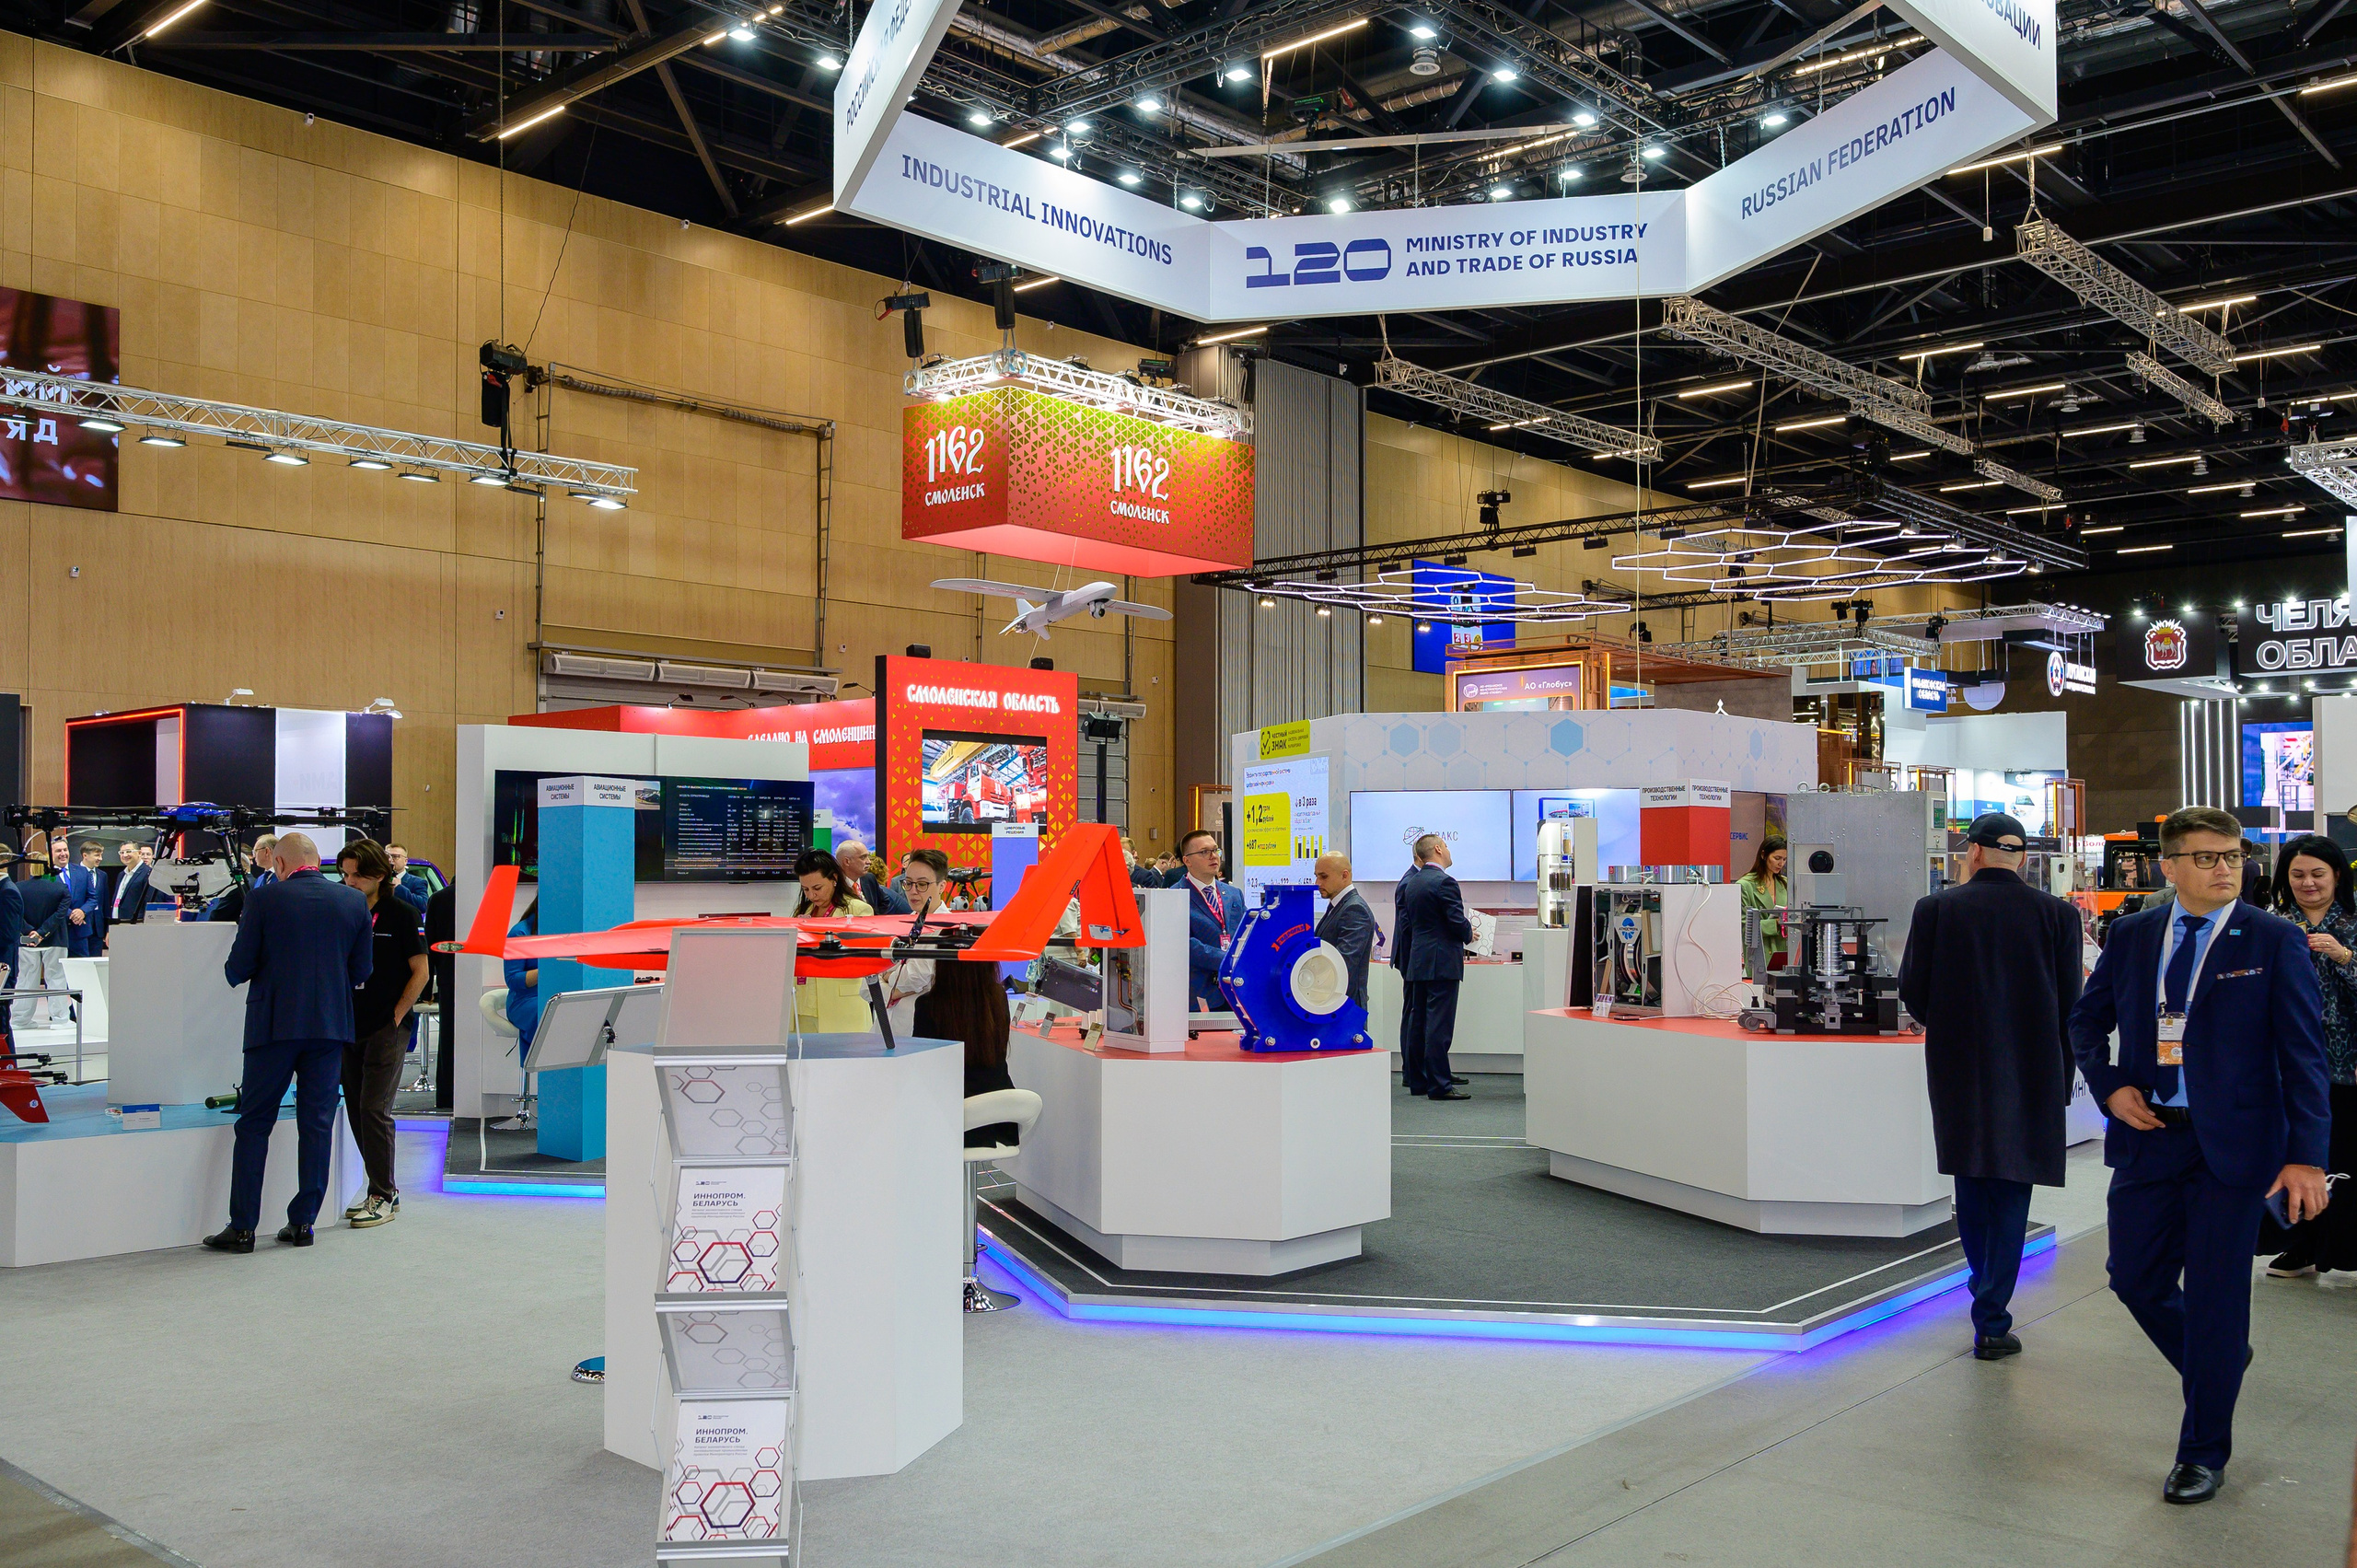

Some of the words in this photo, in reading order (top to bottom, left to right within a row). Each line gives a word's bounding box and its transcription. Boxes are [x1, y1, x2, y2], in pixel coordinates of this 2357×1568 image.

[1741, 157, 1822, 220] RUSSIAN
[1828, 87, 1956, 176] FEDERATION
[901, 154, 1036, 220] INDUSTRIAL
[1040, 202, 1173, 265] INNOVATIONS
[1406, 231, 1504, 253] MINISTRY
[1509, 229, 1536, 248] OF
[1543, 223, 1648, 244] INDUSTRY
[1246, 238, 1391, 288] 120
[1406, 260, 1446, 277] AND
[1448, 254, 1524, 273] TRADE
[1534, 253, 1557, 270] OF
[1562, 248, 1638, 268] RUSSIA
[924, 424, 984, 483] 1162
[1109, 444, 1169, 502] 1162
[924, 482, 985, 506] СМОЛЕНСК
[1109, 499, 1170, 525] СМОЛЕНСК
[2256, 598, 2357, 632] ЧЕЛЯ
[2256, 635, 2357, 669] ОБЛА
[1524, 682, 1536, 691] АО
[1538, 680, 1573, 690] «Глобус»
[907, 684, 997, 708] СМОЛЕНСКАЯ
[1003, 692, 1060, 714] ОБЛАСТЬ
[795, 730, 808, 744] НА
[1271, 739, 1287, 751] ЗНАК
[546, 784, 575, 792] АВИАЦИОННЫЕ
[593, 784, 626, 792] АВИАЦИОННЫЕ
[1642, 785, 1686, 794] ПРОИЗВОДСТВЕННЫЕ
[1692, 784, 1728, 793] ПРОИЗВОДСТВЕННЫЕ
[1303, 796, 1306, 807] 3
[1247, 805, 1263, 826] +1,2
[1429, 830, 1458, 842] АКС
